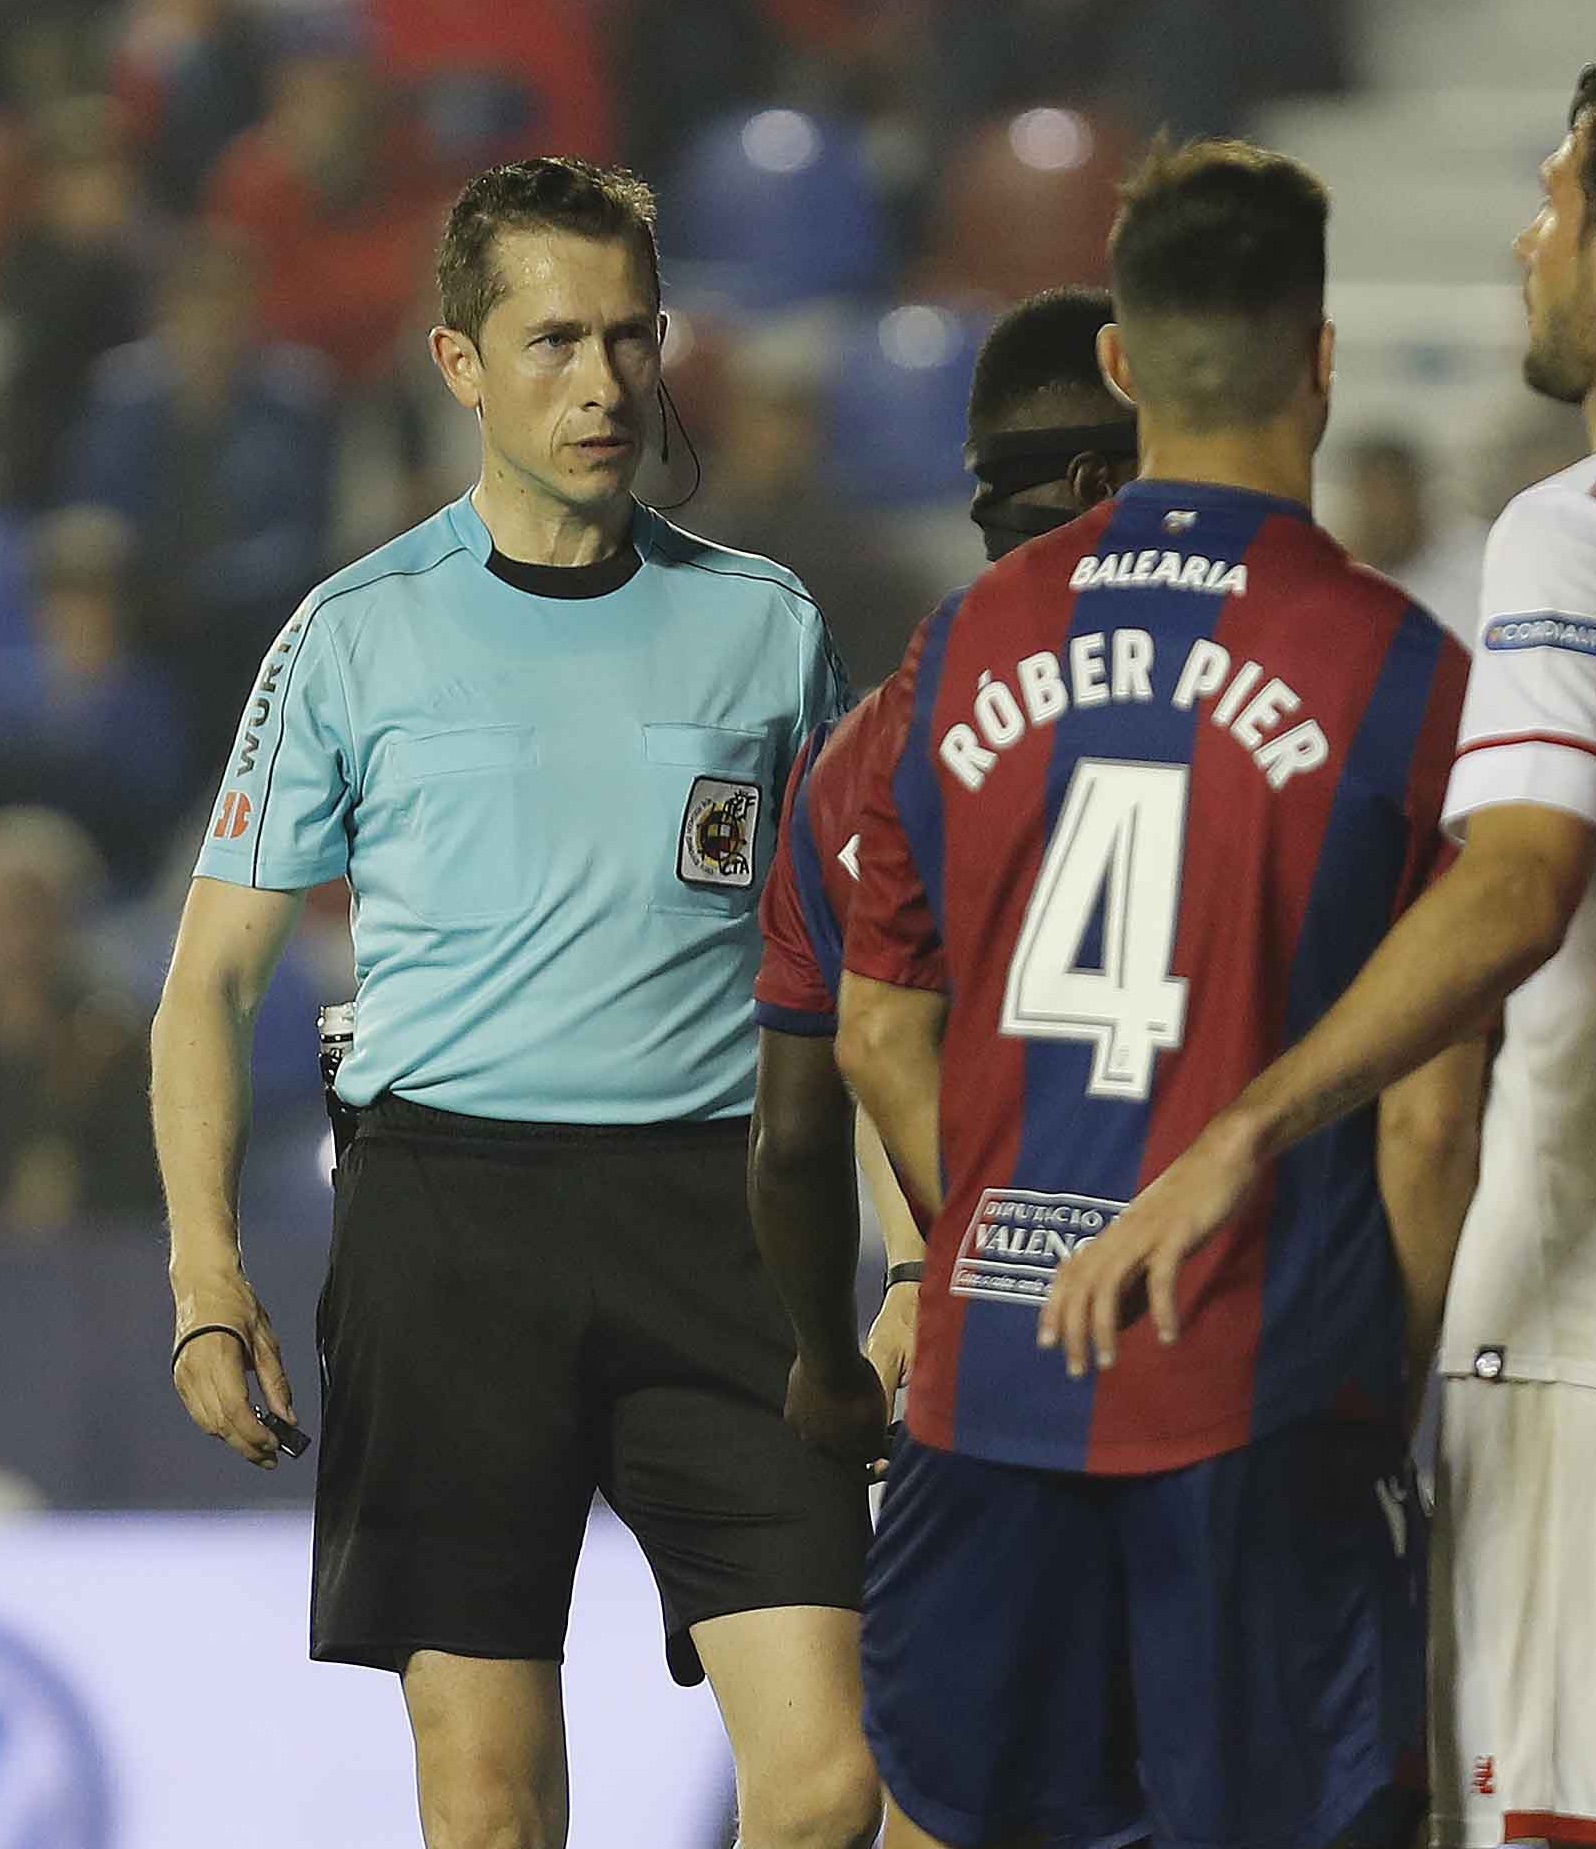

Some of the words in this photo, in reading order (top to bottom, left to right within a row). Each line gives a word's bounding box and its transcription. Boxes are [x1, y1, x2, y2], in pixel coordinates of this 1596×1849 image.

[938, 628, 1155, 792] RÓBER
[1171, 636, 1330, 791] PIER
[998, 755, 1191, 1103] 4
